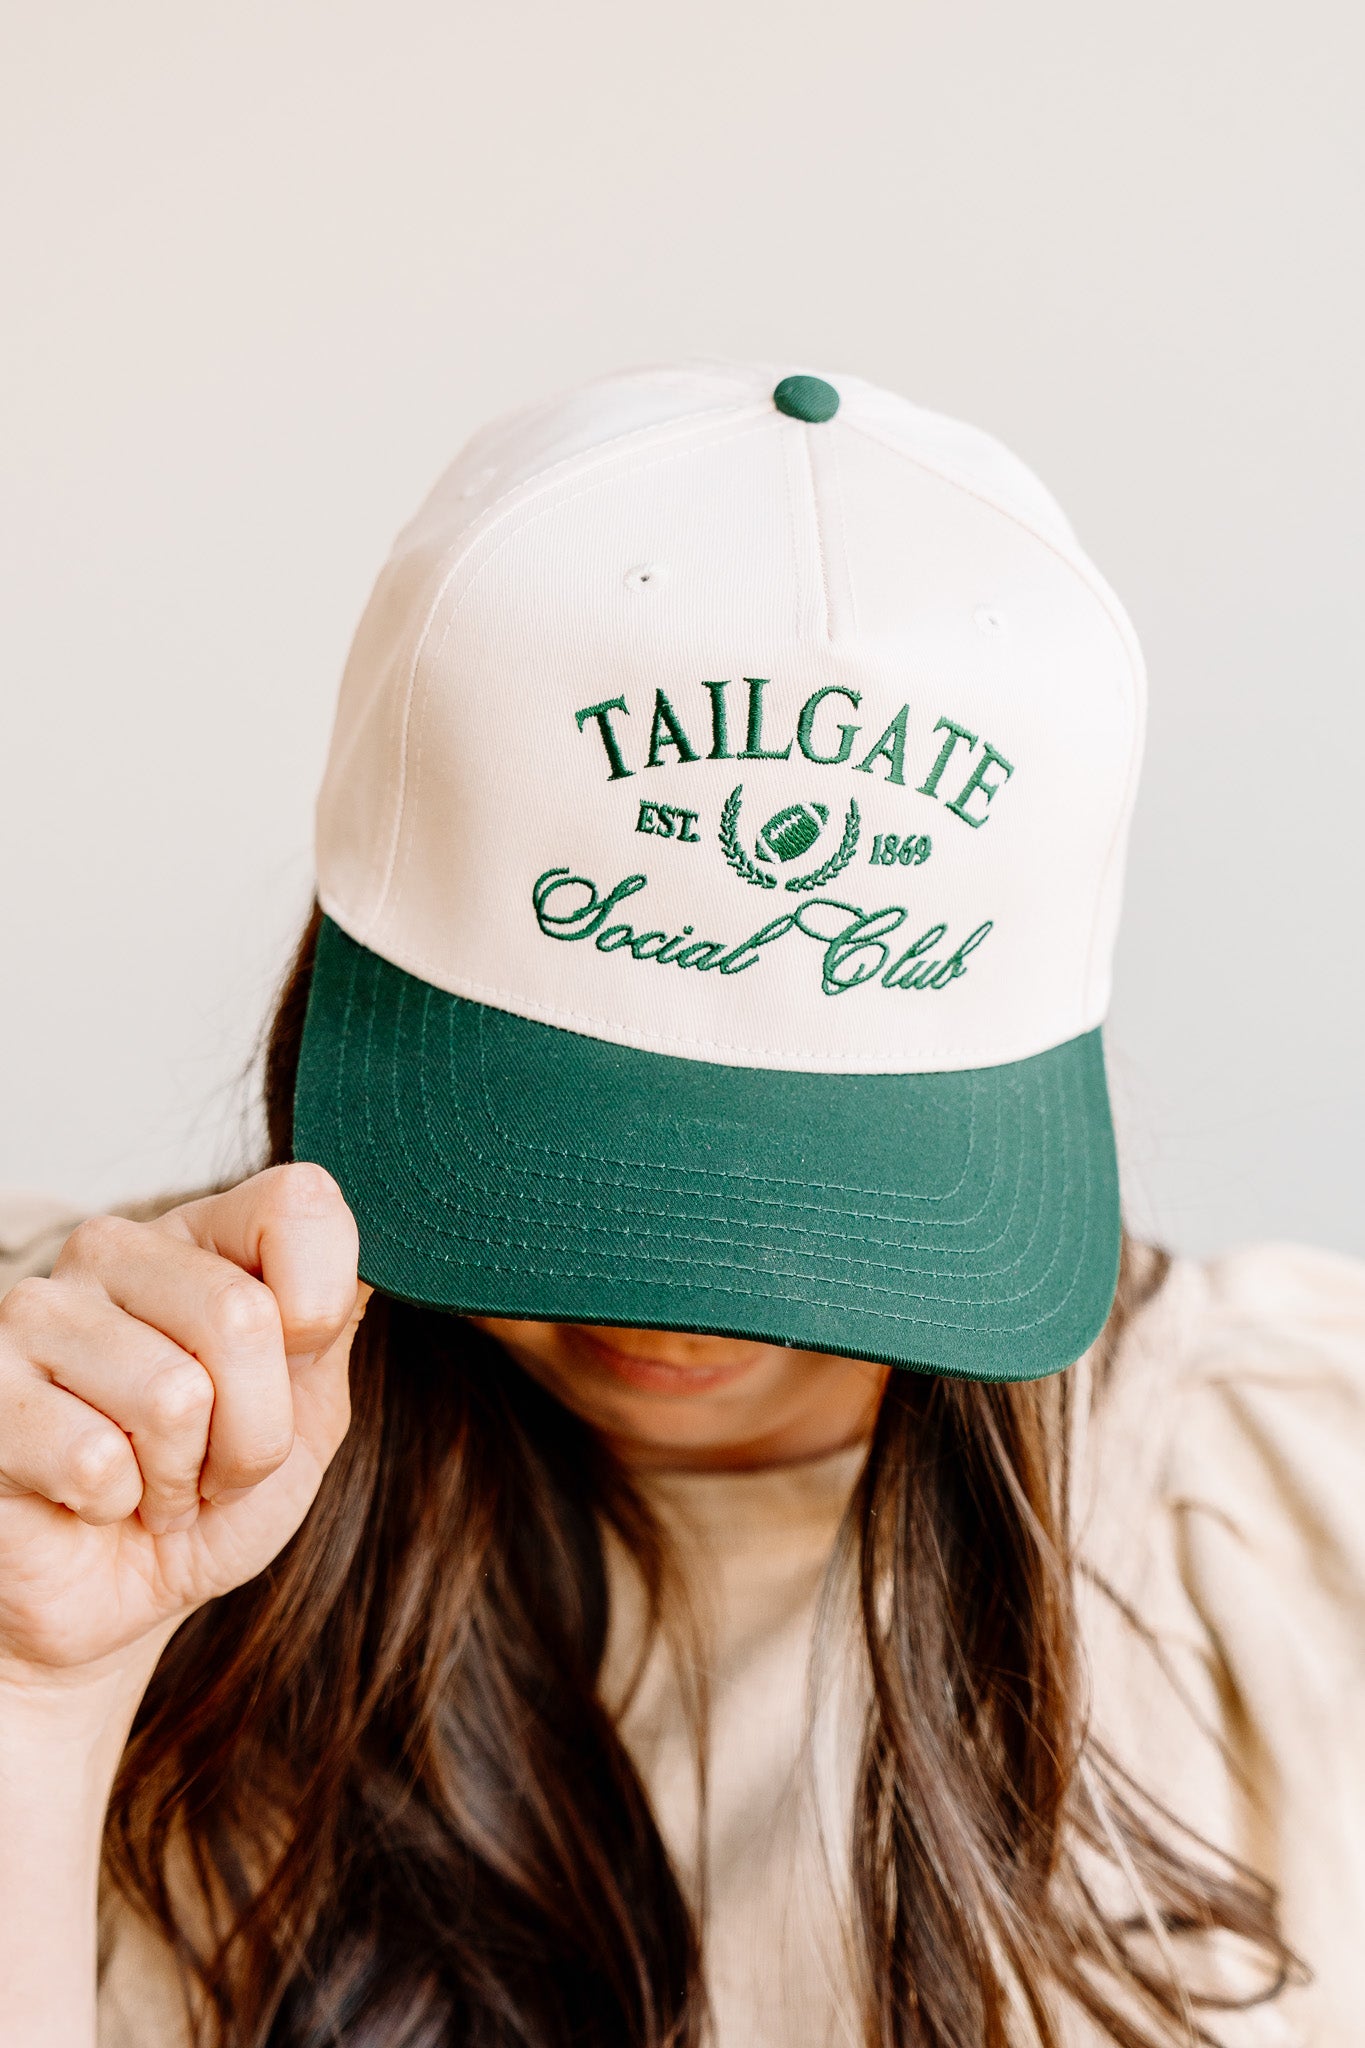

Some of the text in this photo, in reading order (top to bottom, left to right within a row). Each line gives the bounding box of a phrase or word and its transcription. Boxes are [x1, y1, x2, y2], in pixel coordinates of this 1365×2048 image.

[575, 677, 1015, 829] TAILGATE
[635, 798, 932, 866] EST. 1869
[532, 867, 993, 996] Social Club
